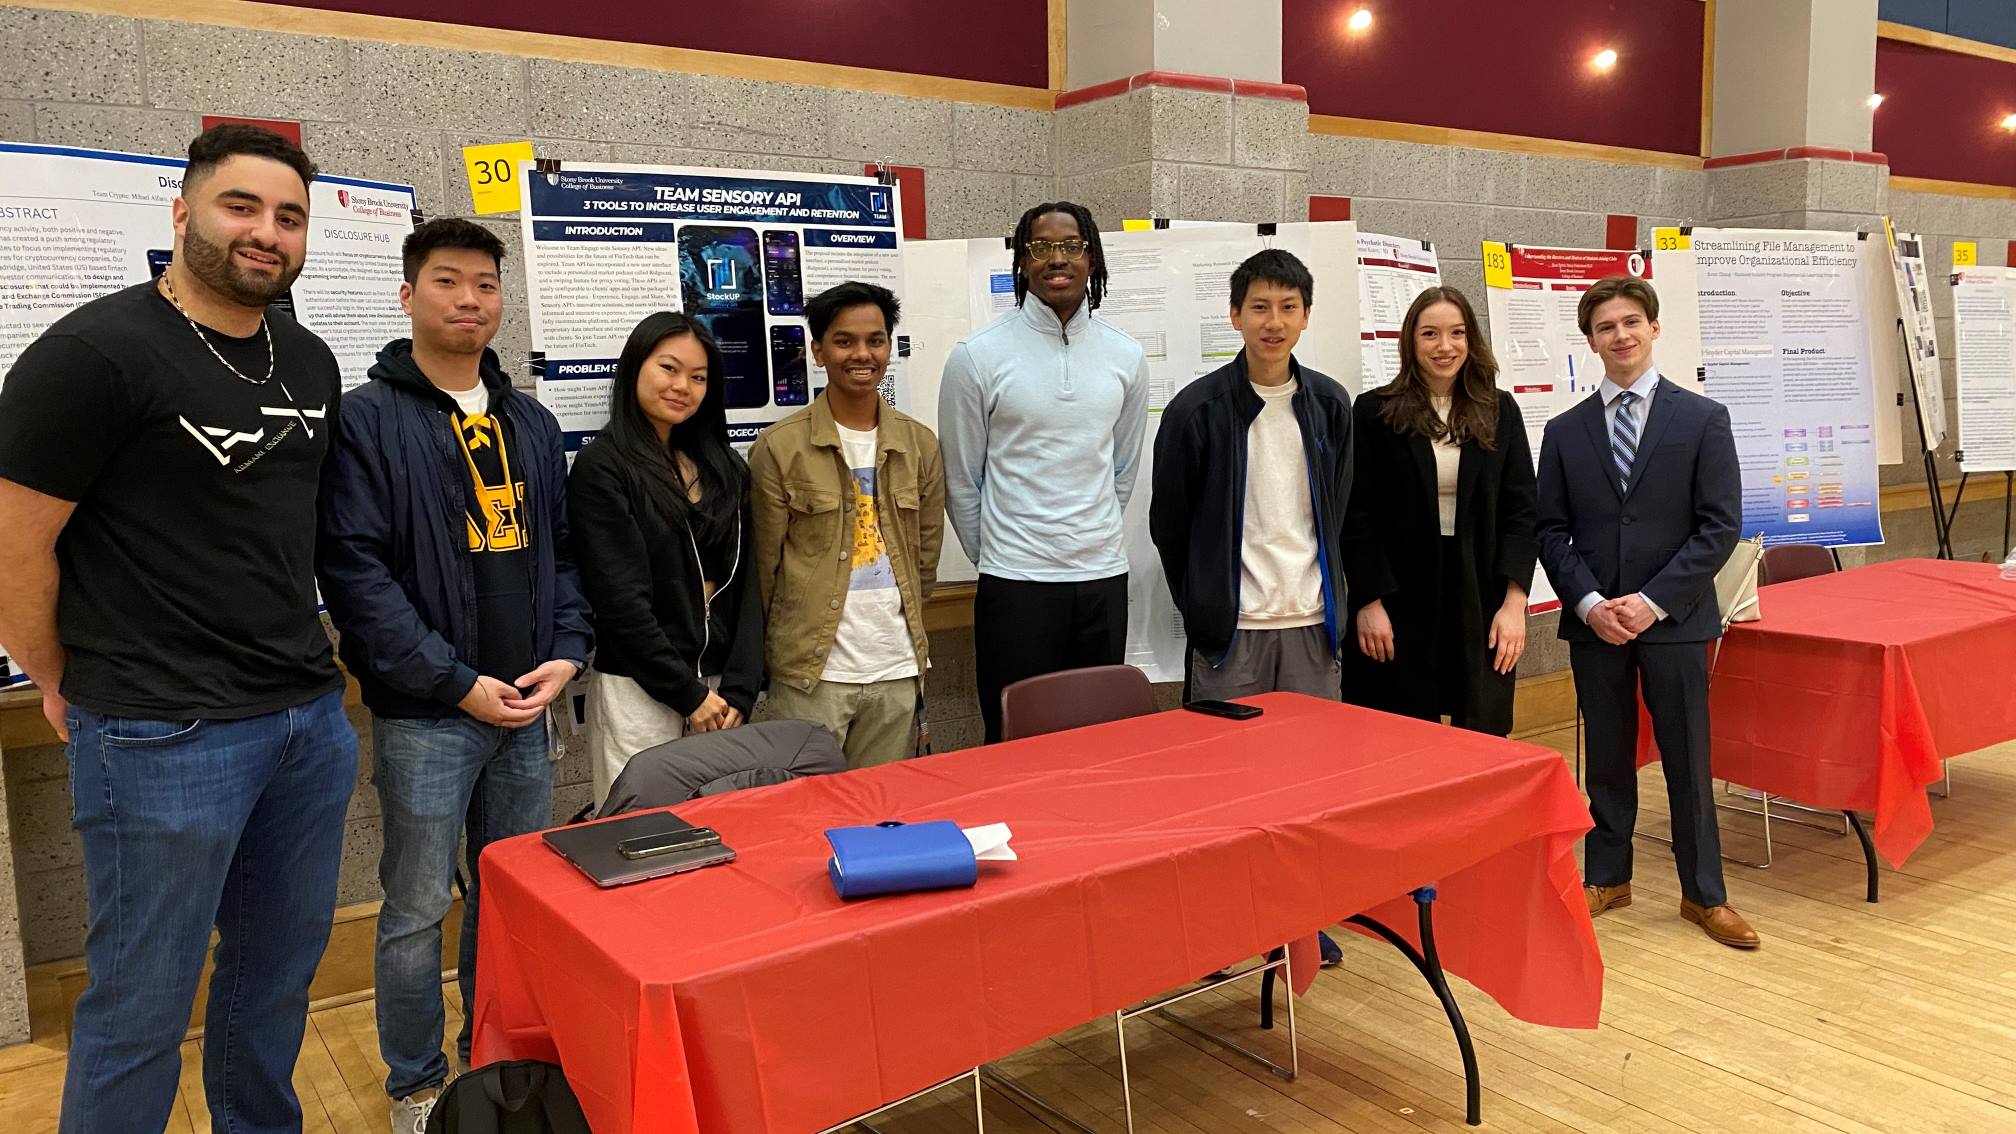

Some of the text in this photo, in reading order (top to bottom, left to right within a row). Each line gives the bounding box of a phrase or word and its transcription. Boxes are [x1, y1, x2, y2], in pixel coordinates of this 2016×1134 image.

[474, 159, 511, 185] 30
[561, 176, 577, 184] Stony
[595, 177, 624, 185] University
[92, 190, 108, 198] Team
[654, 186, 802, 206] TEAM SENSORY API
[351, 196, 409, 210] Stony Brook University
[353, 205, 401, 217] College of Business
[583, 201, 860, 219] 3 TOOLS TO INCREASE USER ENGAGEMENT AND RETENTION
[13, 226, 41, 234] activity,
[60, 227, 85, 235] positive
[325, 229, 390, 243] DISCLOSURE HUB
[565, 226, 643, 236] INTRODUCTION
[46, 236, 62, 244] push
[64, 237, 86, 245] among
[830, 234, 876, 243] OVERVIEW
[1660, 238, 1678, 250] 33
[52, 246, 96, 254] implementing
[1694, 240, 1855, 253] Streamlining File Management to
[25, 255, 76, 263] cryptocurrency
[1956, 250, 1968, 261] 35
[1487, 253, 1505, 270] 183
[1696, 255, 1857, 268] mprove Organizational Efficiency
[706, 292, 740, 300] StockUP
[558, 364, 610, 374] PROBLEM
[234, 420, 297, 474] ARMANI EXCHANGE
